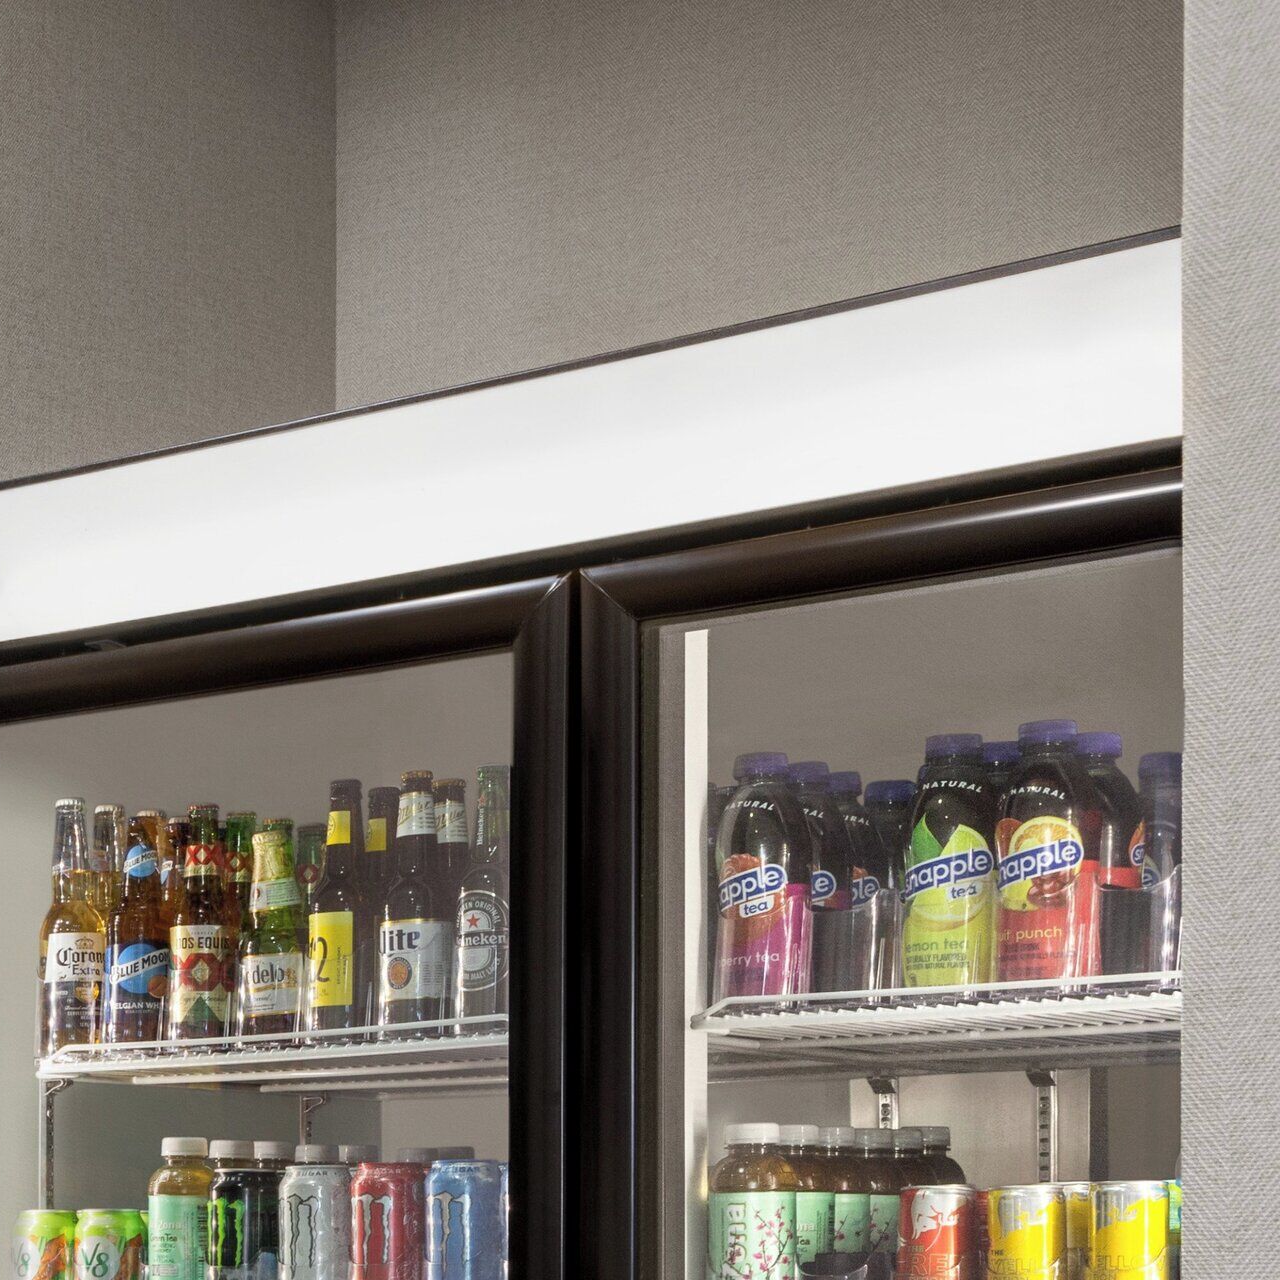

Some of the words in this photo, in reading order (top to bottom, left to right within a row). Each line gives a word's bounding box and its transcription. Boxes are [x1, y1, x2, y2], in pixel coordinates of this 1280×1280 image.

[923, 780, 982, 793] NATURAL
[1011, 786, 1065, 800] NATURAL
[951, 883, 977, 899] tea
[743, 900, 768, 916] tea
[1016, 927, 1062, 941] punch
[198, 936, 230, 949] EQUIS
[72, 964, 101, 976] Extra
